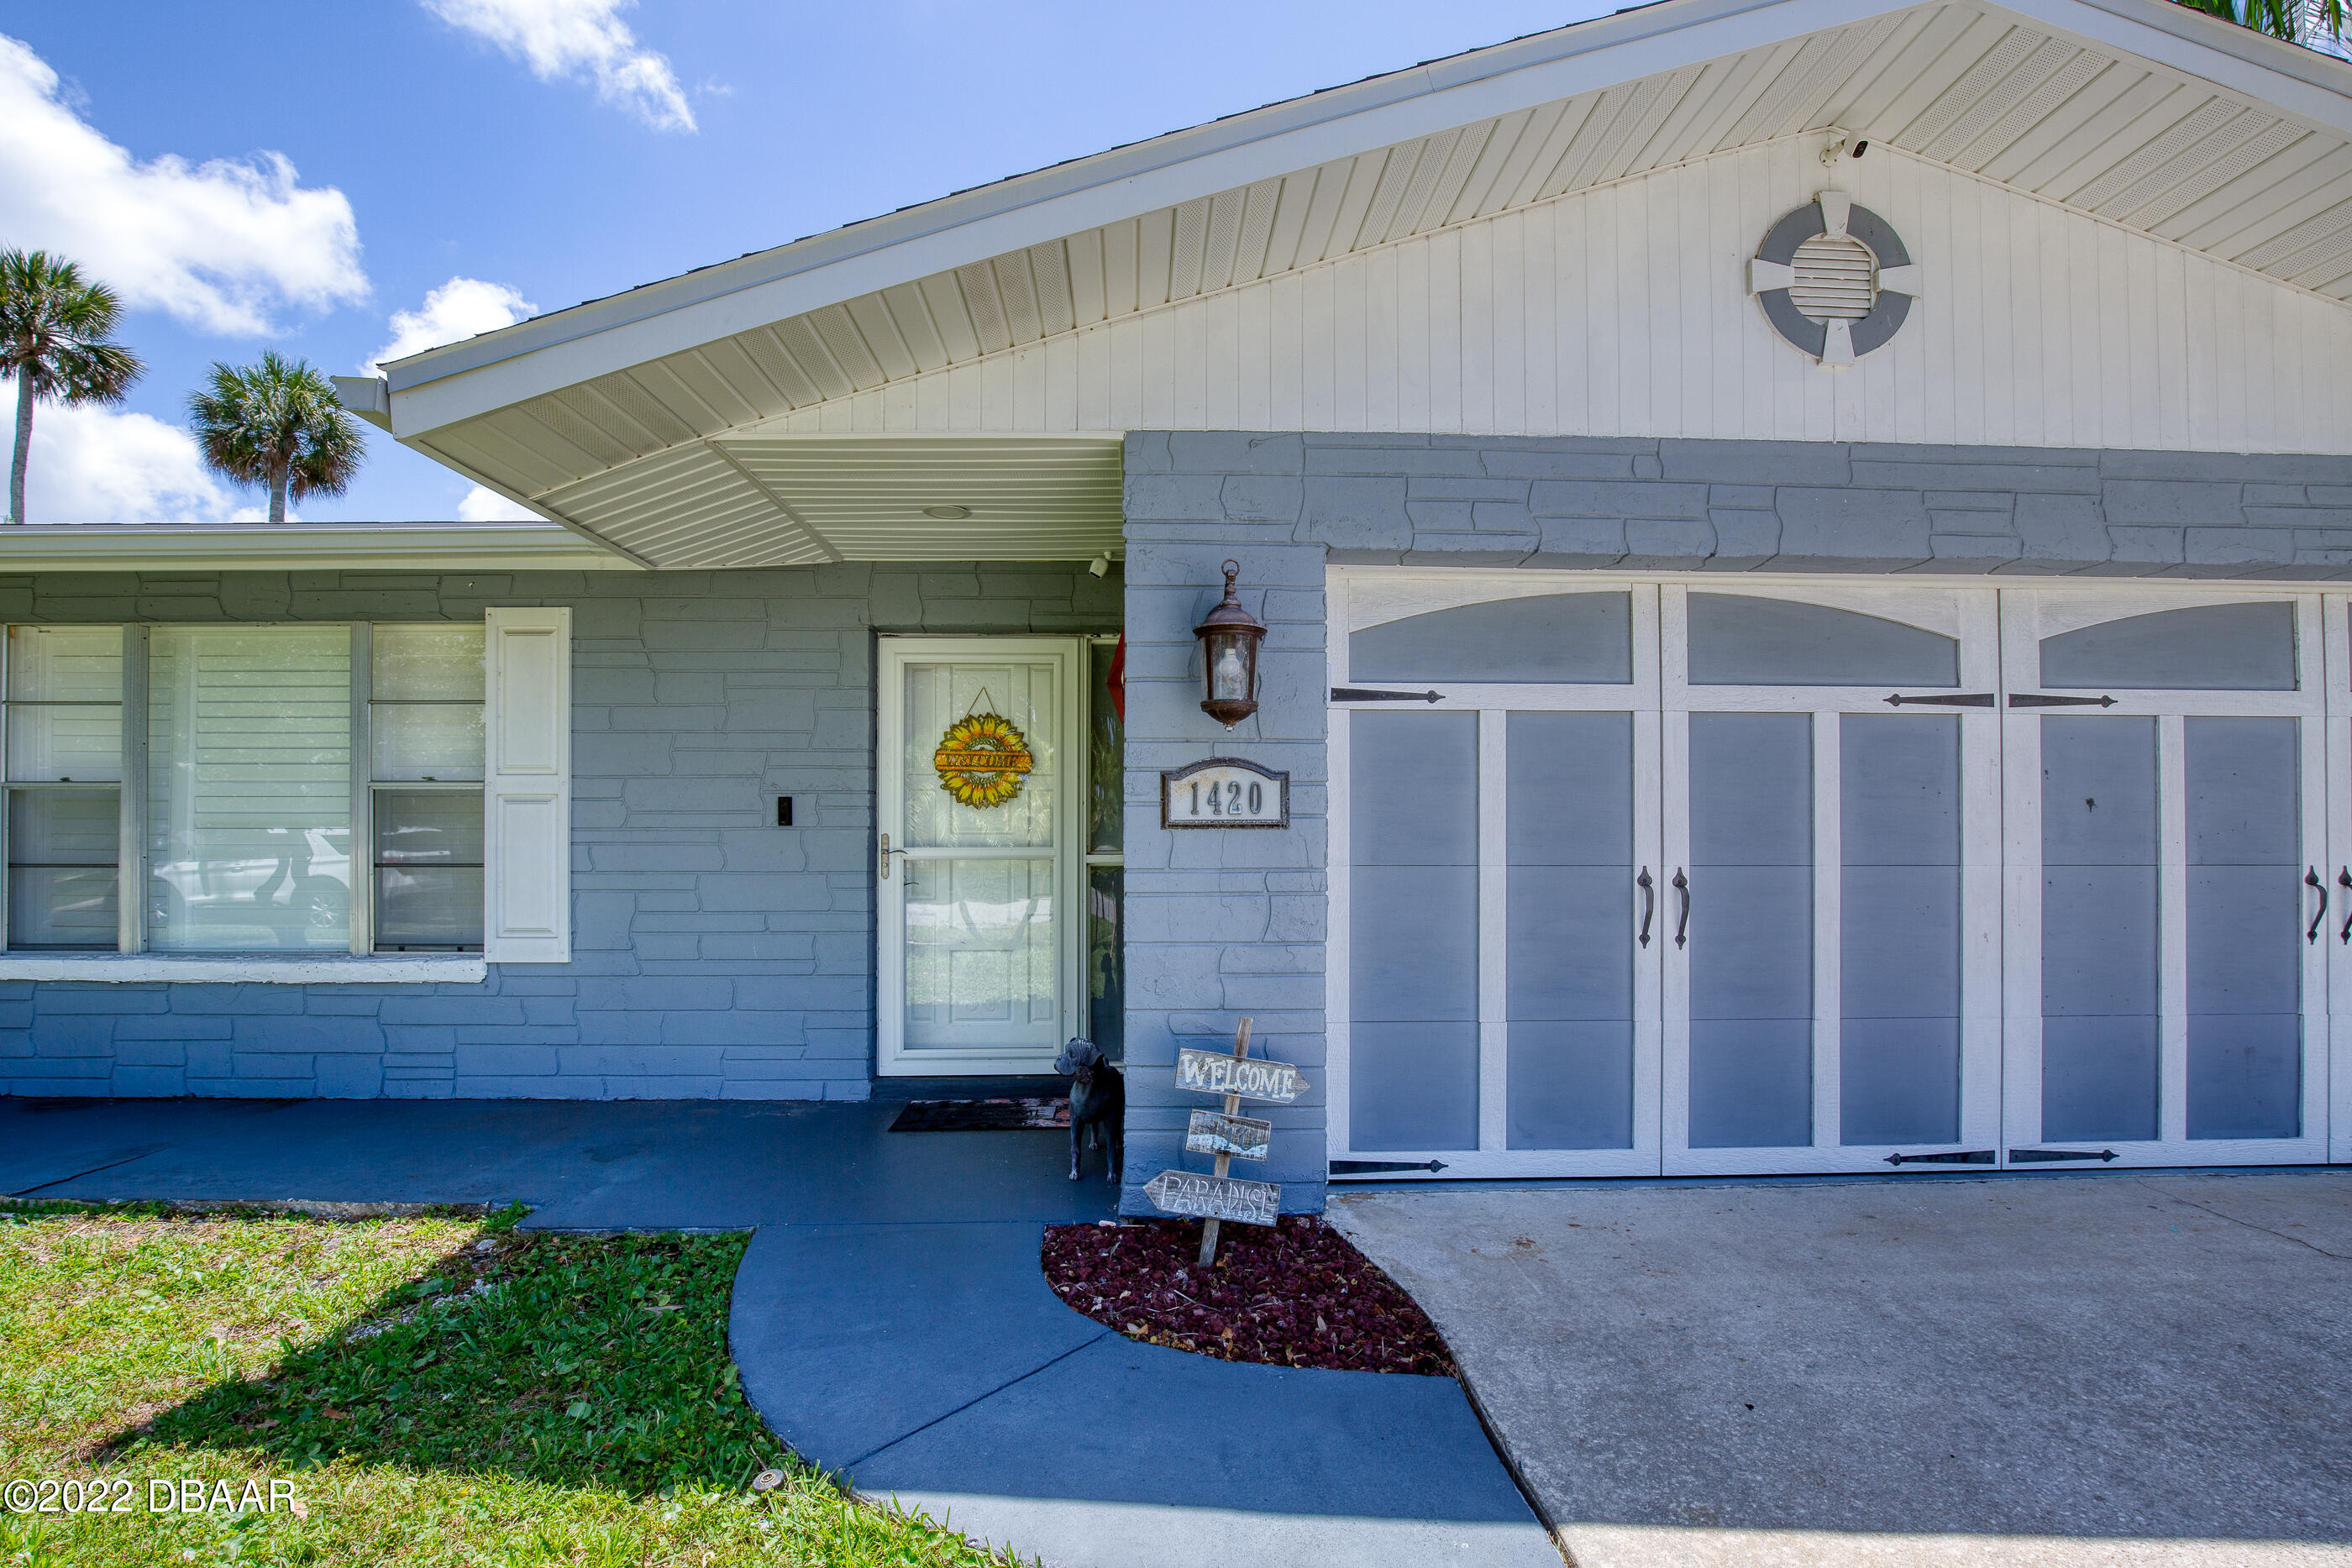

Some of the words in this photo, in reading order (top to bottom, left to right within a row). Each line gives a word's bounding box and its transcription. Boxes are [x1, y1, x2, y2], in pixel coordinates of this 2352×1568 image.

[945, 754, 1018, 768] WELCOME
[1190, 780, 1263, 815] 1420
[1181, 1054, 1296, 1099] WELCOME
[1160, 1176, 1276, 1220] PARADISE
